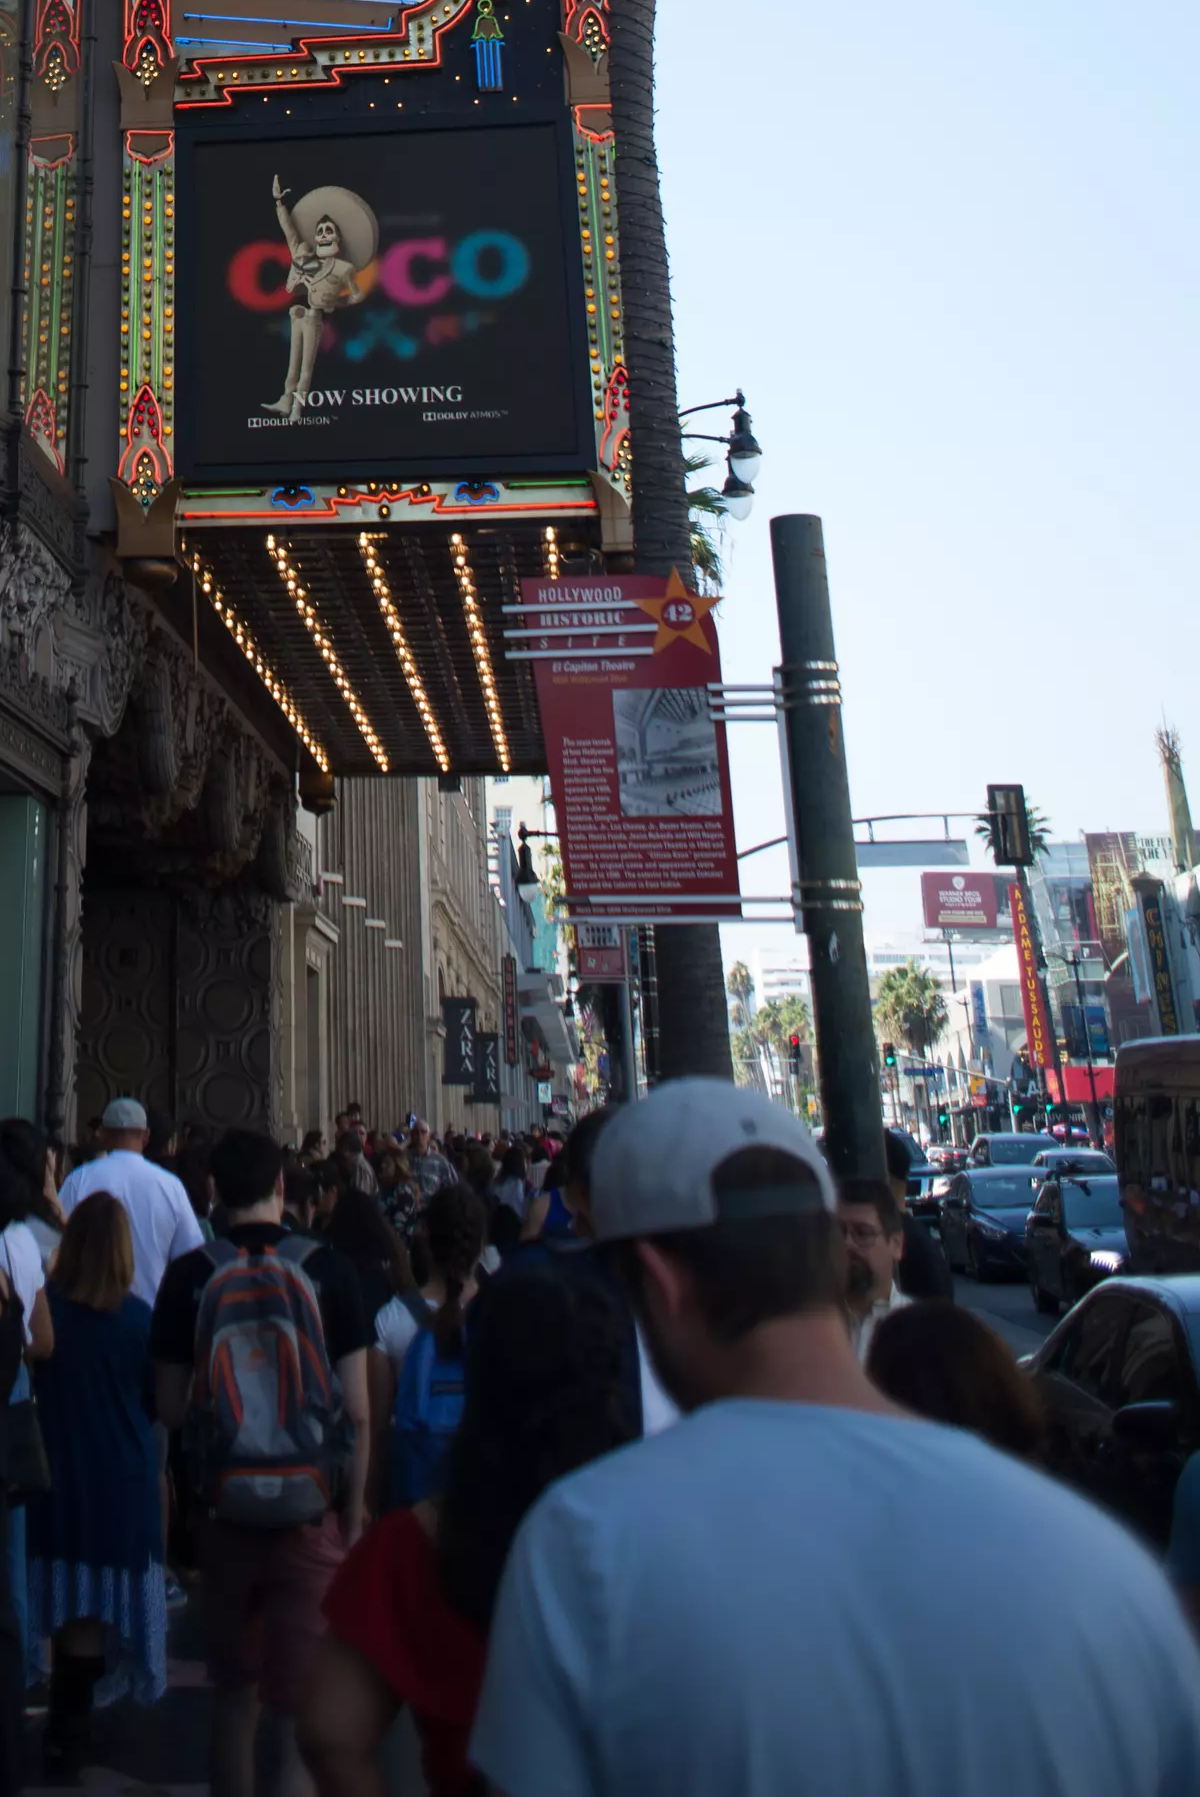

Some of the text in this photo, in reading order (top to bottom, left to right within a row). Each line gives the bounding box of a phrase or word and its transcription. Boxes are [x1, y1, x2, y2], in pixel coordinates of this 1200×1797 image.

[227, 229, 529, 311] CCO
[292, 385, 463, 407] NOW SHOWING
[437, 410, 468, 420] DOLBY
[538, 586, 622, 603] HOLLYWOOD
[540, 611, 625, 626] HISTORIC
[663, 603, 693, 622] 42
[540, 634, 626, 649] SITE
[563, 660, 598, 674] Capitan
[601, 660, 635, 672] Theatre
[1014, 889, 1045, 1065] MADAME TUSSAUDS
[460, 1008, 474, 1072] ZARA
[485, 1041, 497, 1093] ZARA
